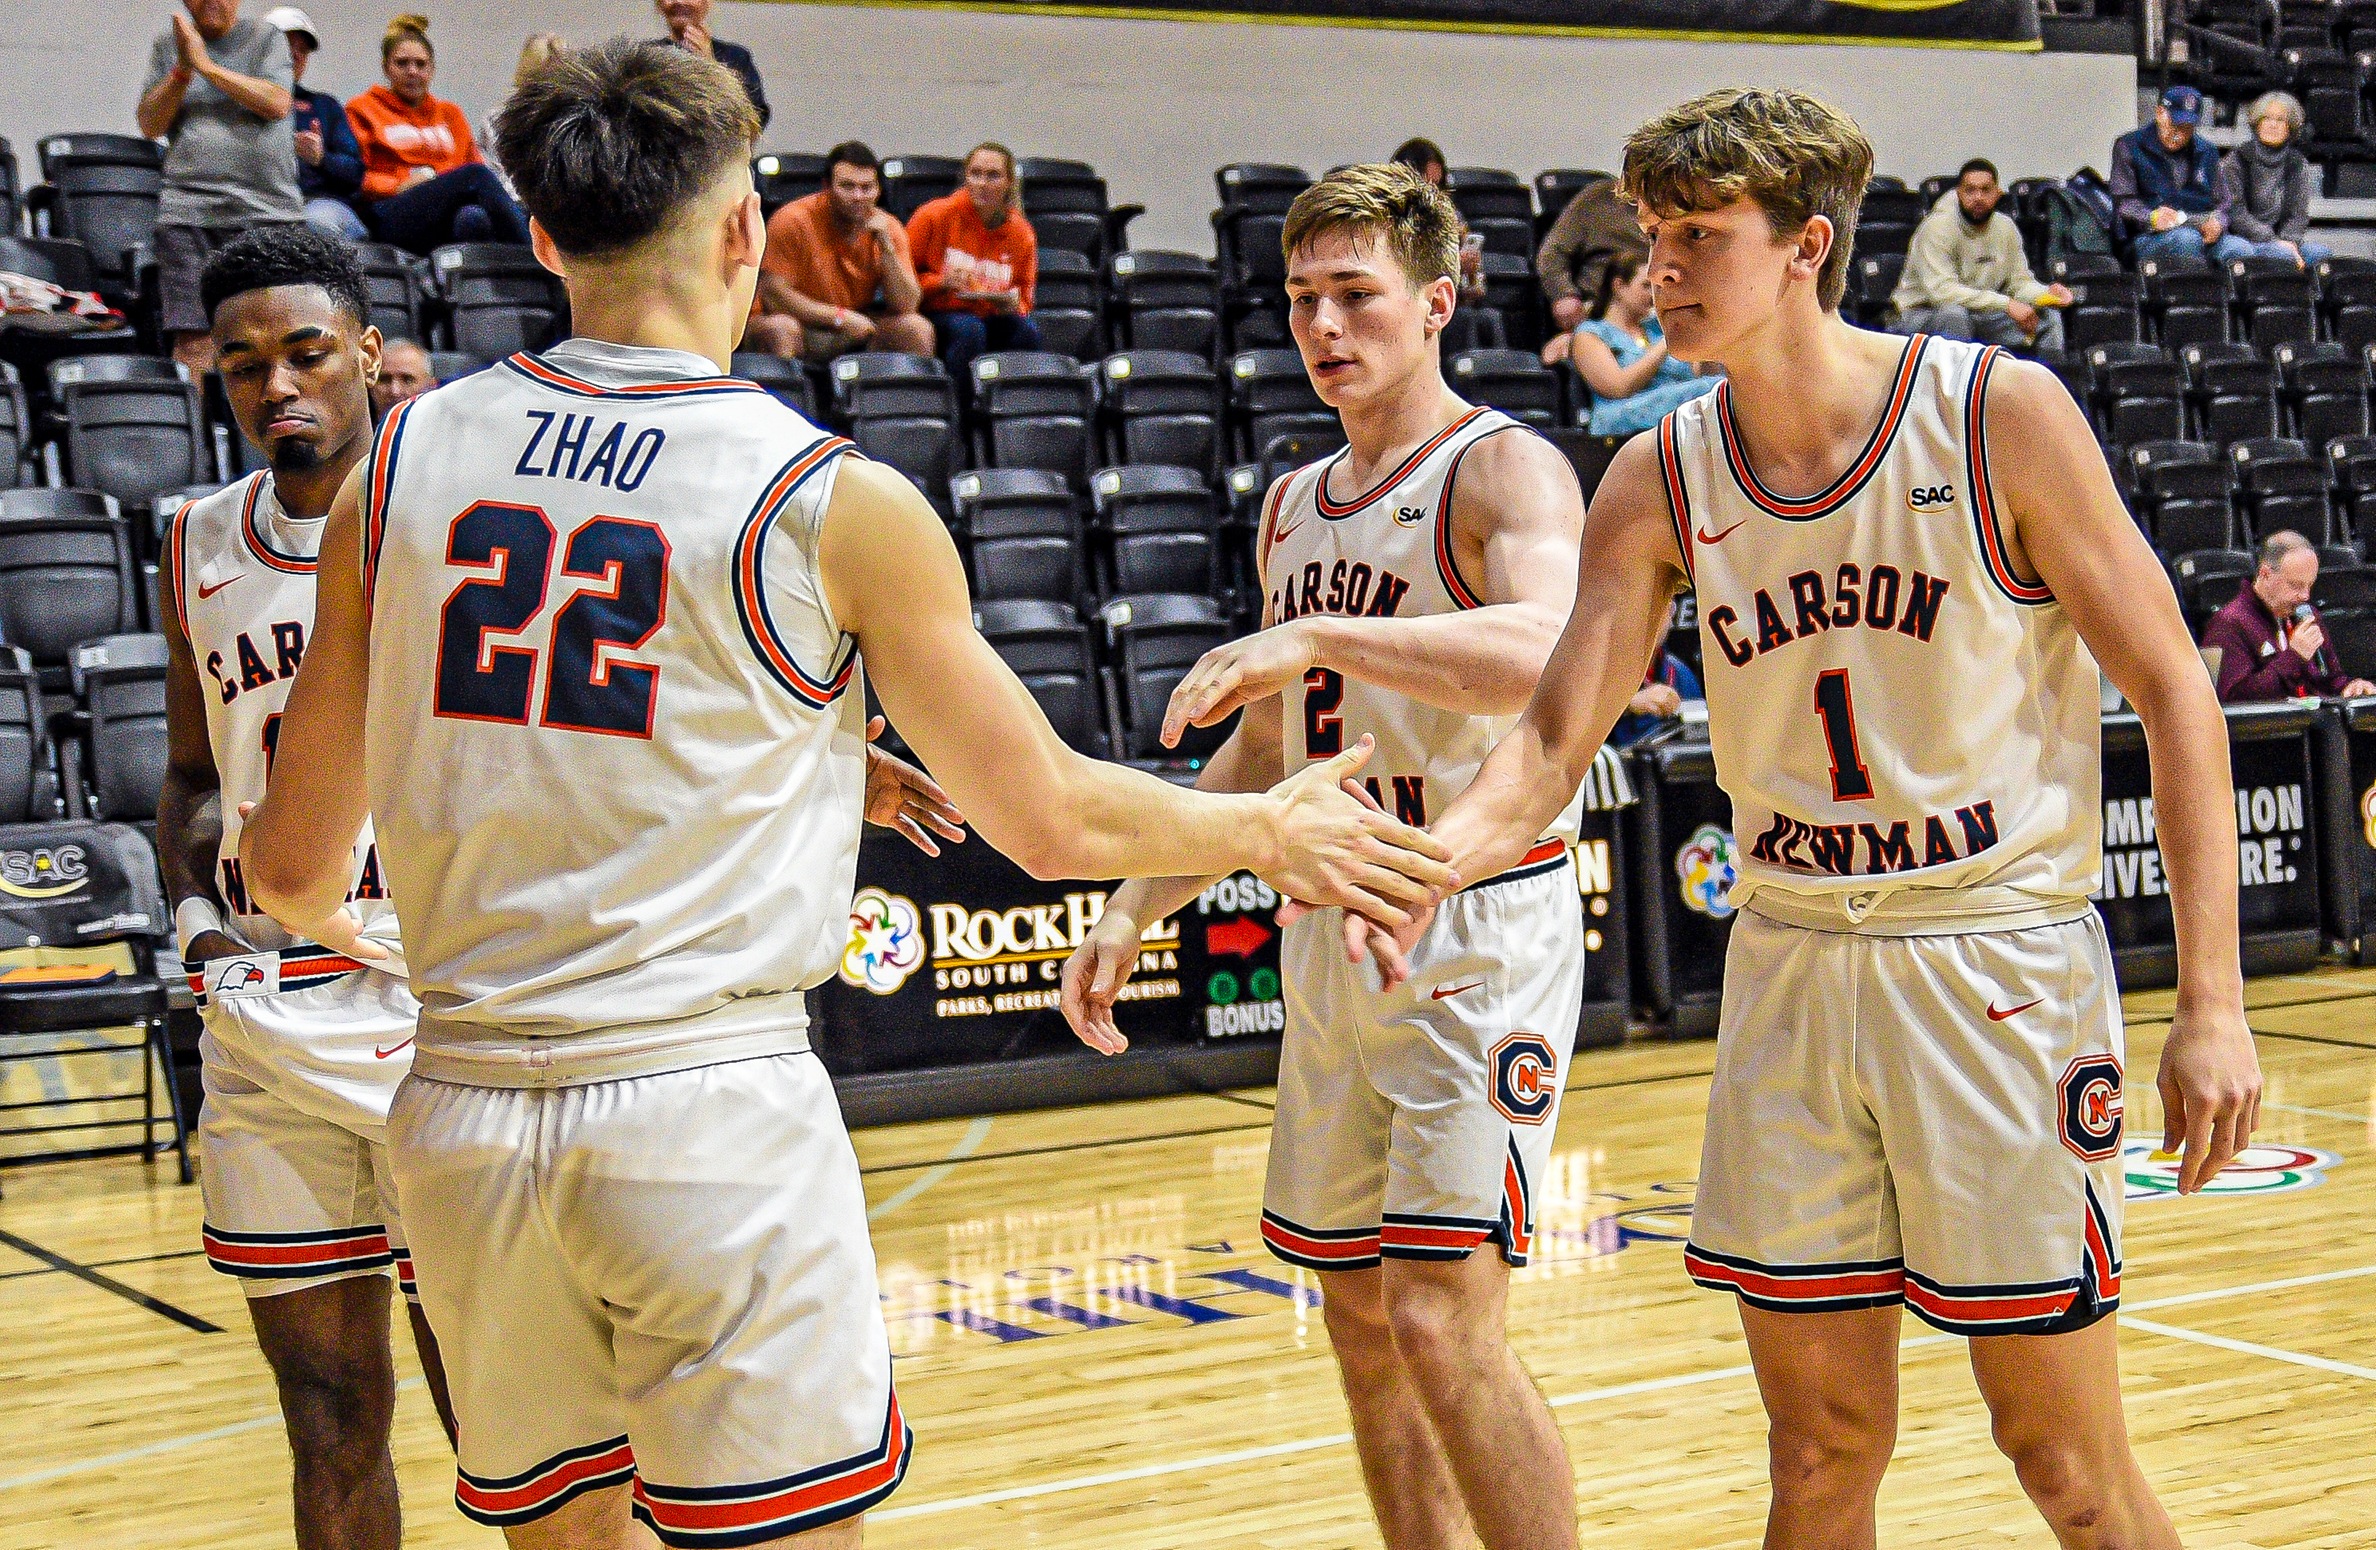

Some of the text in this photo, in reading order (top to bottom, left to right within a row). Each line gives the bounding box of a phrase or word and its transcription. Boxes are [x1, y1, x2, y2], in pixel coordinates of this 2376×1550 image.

[514, 409, 667, 493] ZHAO
[1911, 484, 1955, 506] SAC
[433, 499, 673, 741] 22
[1707, 561, 1951, 668] CARSON
[1813, 667, 1876, 802] 1
[0, 844, 90, 885] SAC
[1749, 799, 2001, 877] NEWMAN
[935, 962, 1028, 990] SOUTH
[937, 996, 993, 1018] PARKS,
[1118, 979, 1181, 1001] OURISM
[1207, 1001, 1284, 1036] BONUS
